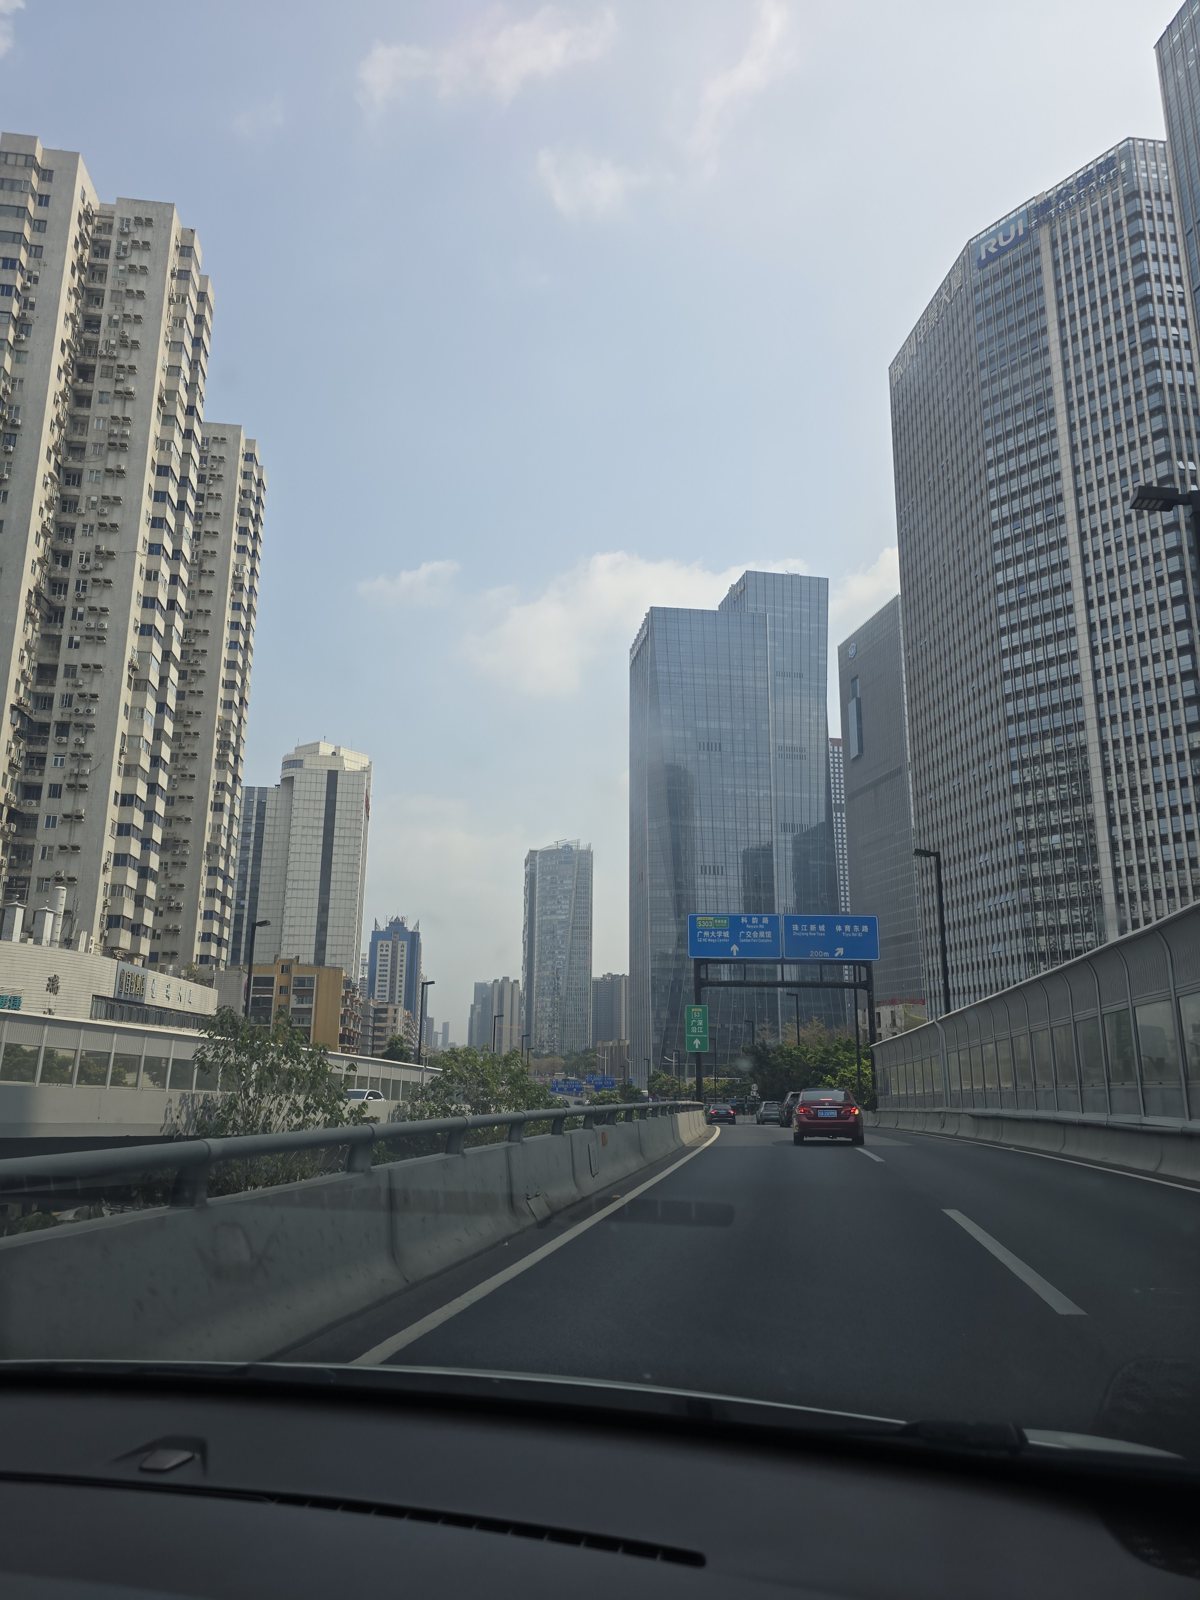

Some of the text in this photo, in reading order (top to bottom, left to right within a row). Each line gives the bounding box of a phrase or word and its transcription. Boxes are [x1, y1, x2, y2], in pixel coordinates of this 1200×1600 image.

[836, 924, 869, 932] 体育东路
[697, 930, 730, 938] 广州大学城
[739, 930, 772, 938] 广交会展馆
